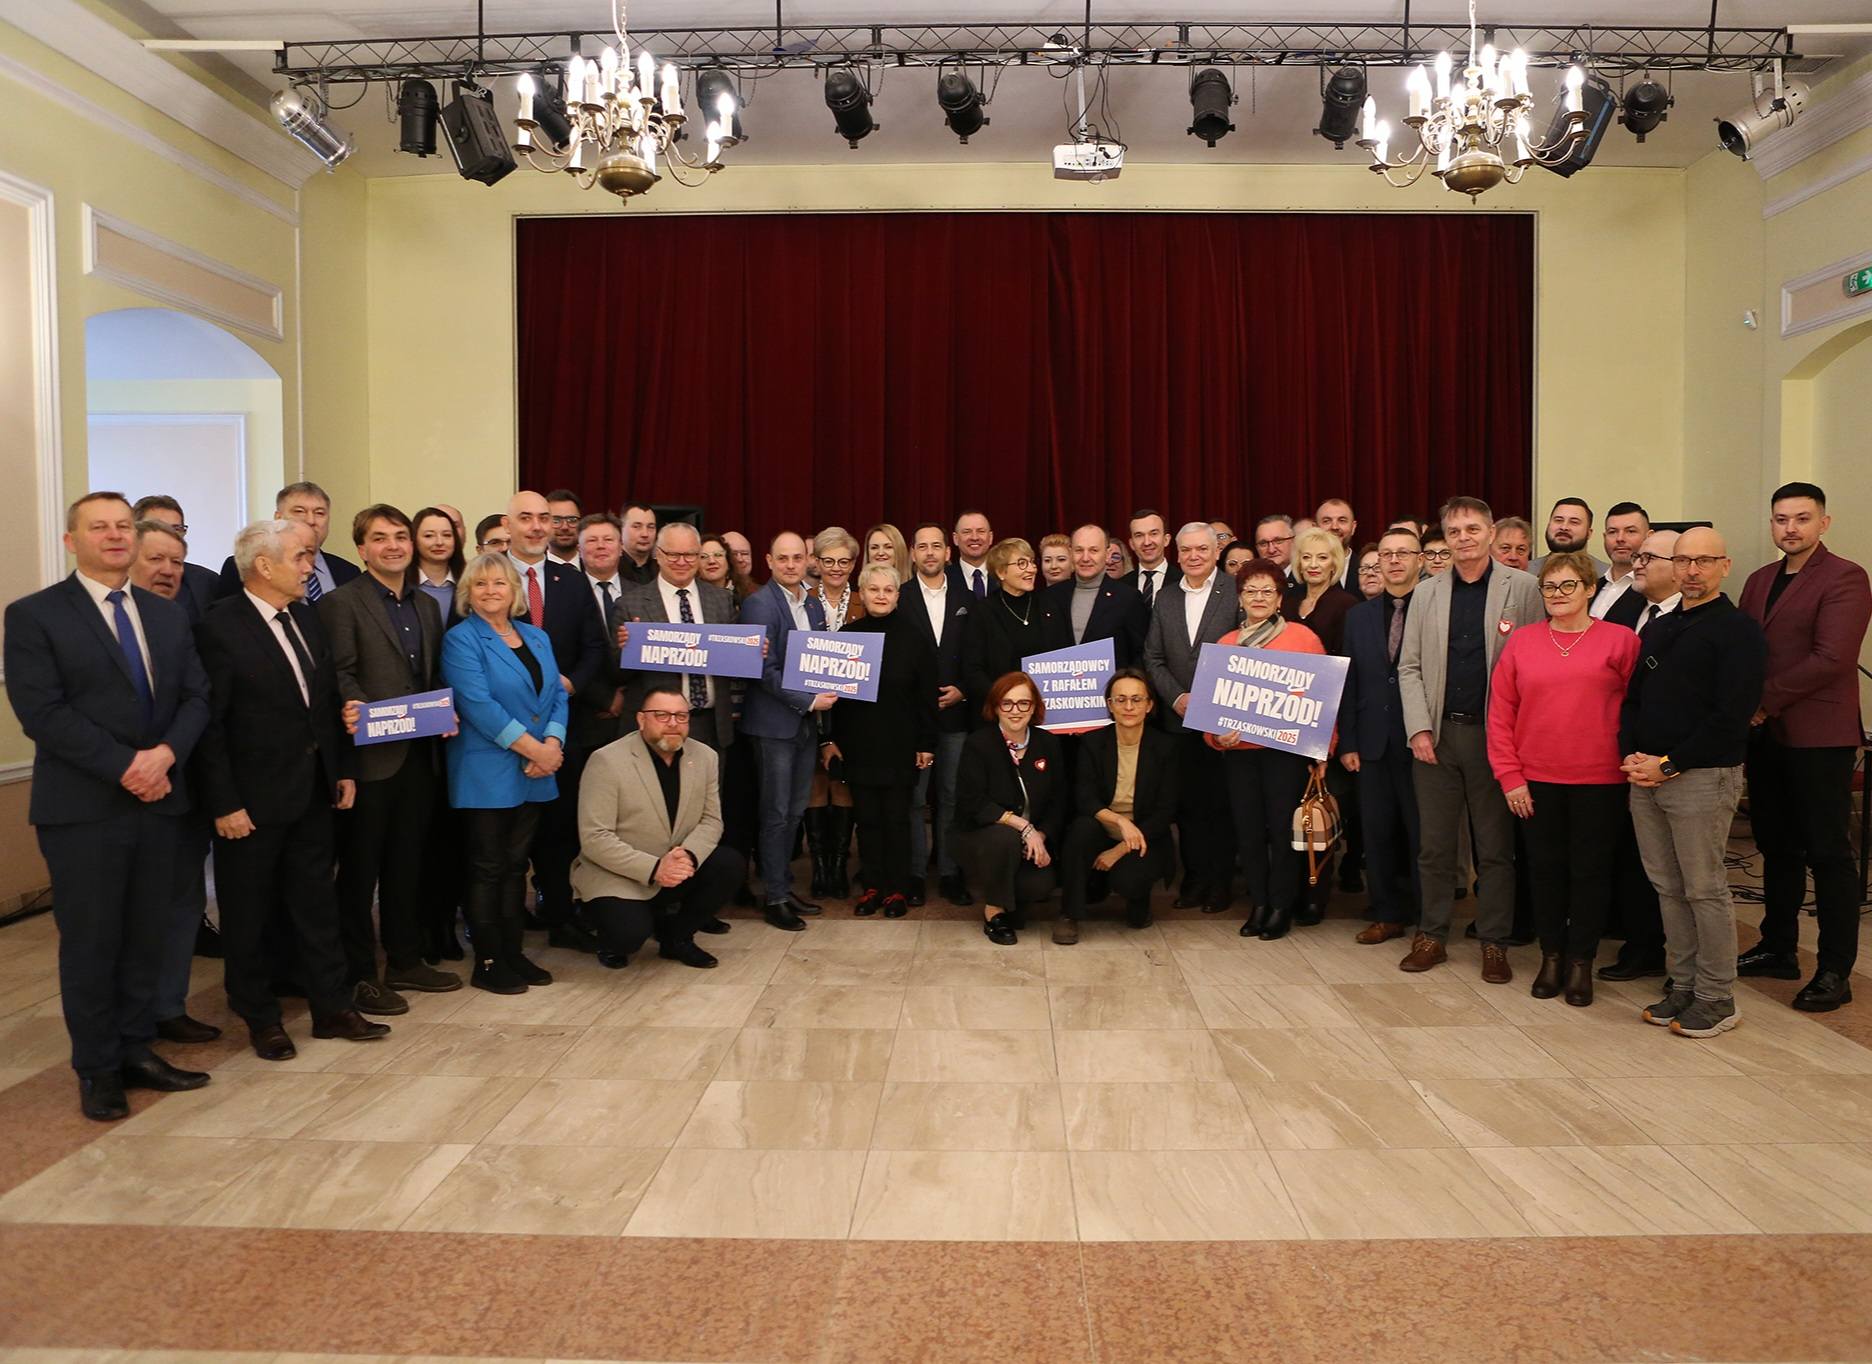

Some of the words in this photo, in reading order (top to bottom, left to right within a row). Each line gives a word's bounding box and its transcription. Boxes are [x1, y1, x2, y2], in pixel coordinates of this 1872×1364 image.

[1042, 680, 1049, 692] Z
[1052, 678, 1097, 692] RAFAŁEM
[1227, 654, 1316, 692] SAMORZĄDY
